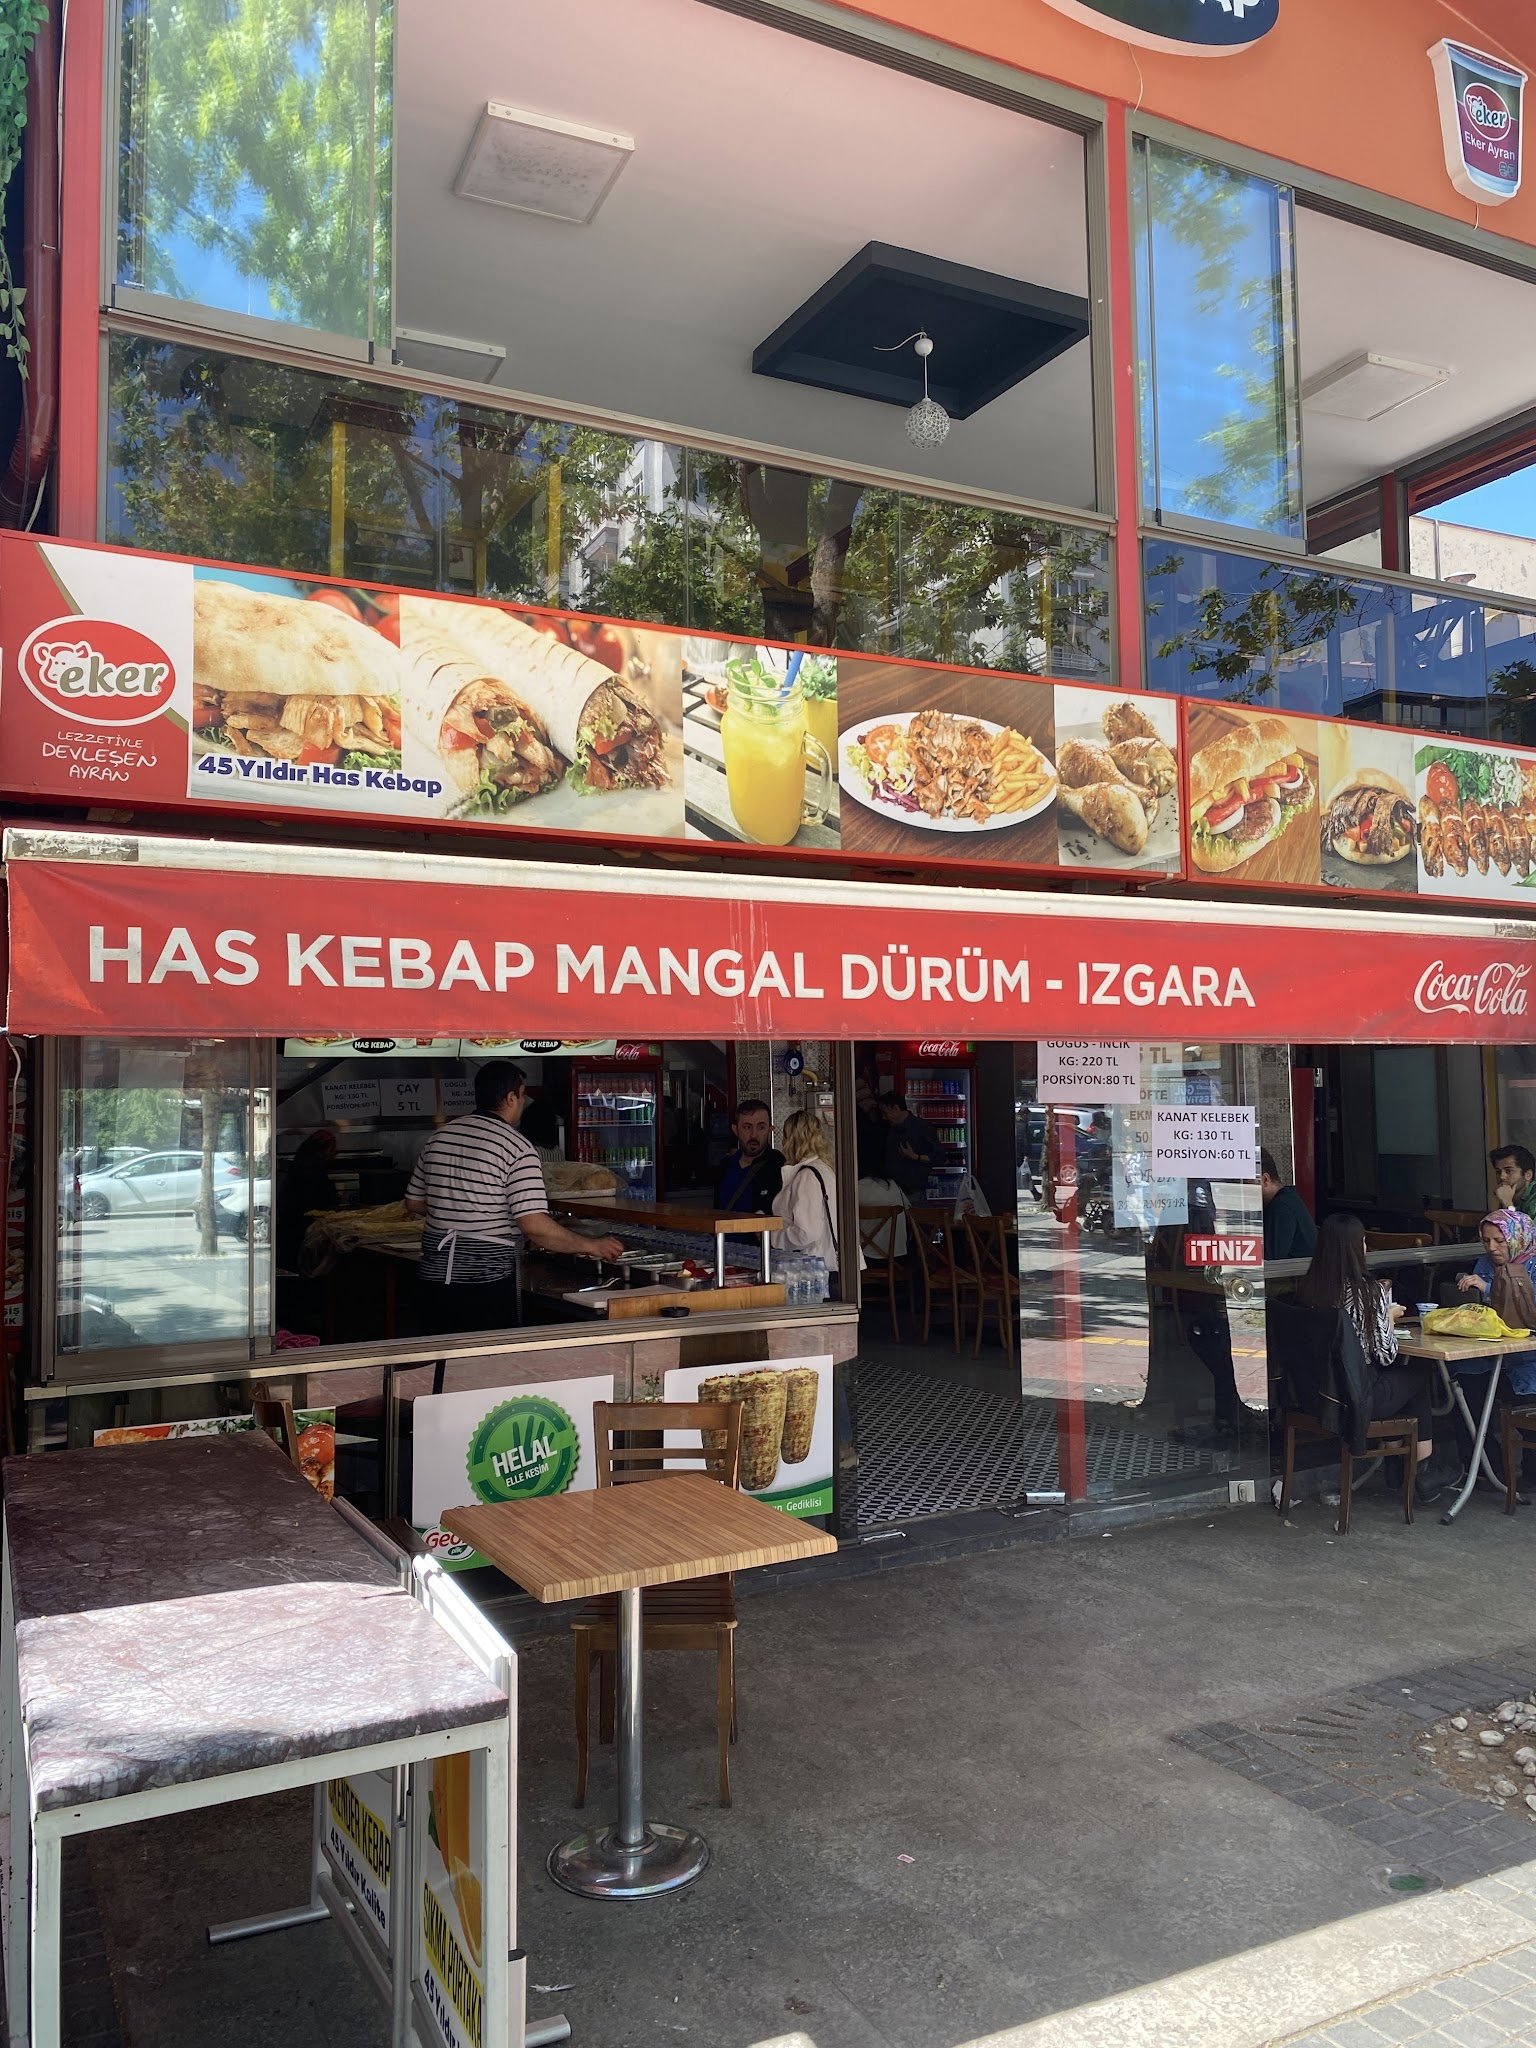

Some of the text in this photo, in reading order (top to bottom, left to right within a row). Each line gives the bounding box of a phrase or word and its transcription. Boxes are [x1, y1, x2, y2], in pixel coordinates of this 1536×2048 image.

[1475, 106, 1506, 127] eker
[1464, 131, 1516, 160] Eker Ayran
[60, 656, 164, 693] eker
[58, 731, 143, 748] LEZZETİYLE
[43, 742, 157, 767] DEVLEŞEN
[69, 765, 130, 782] AYRAN
[198, 756, 442, 798] 45 Yıldır Has Kebap
[89, 926, 259, 986] HAS
[286, 932, 535, 994] KEBAP
[557, 943, 824, 999] MANGAL
[841, 944, 1030, 1003] DÜRÜM
[1078, 962, 1256, 1008] IZGARA
[1413, 960, 1532, 1016] Coca-Cola
[354, 1041, 394, 1049] HAS KEBAP
[523, 1040, 559, 1048] HAS KEBAP
[918, 1040, 960, 1057] Coca-Cola
[1059, 1056, 1119, 1066] KG: 220 TL
[1150, 1047, 1173, 1064] TL
[1122, 1074, 1136, 1085] TL
[396, 1084, 420, 1095] ÇAY
[397, 1101, 421, 1111] 5 TL
[1157, 1112, 1249, 1123] KANAT KELEBEK
[1135, 1131, 1149, 1143] 50
[1173, 1130, 1234, 1141] KG: 130 TL
[1238, 1149, 1251, 1160] TL
[492, 1436, 557, 1477] HELAL
[506, 1463, 550, 1488] ELLE KESİM
[786, 1497, 822, 1511] Gediklisi
[362, 1811, 391, 1887] KEBAP
[330, 1826, 340, 1853] 45
[360, 1873, 386, 1930] Kalite
[424, 1969, 434, 2003] 45
